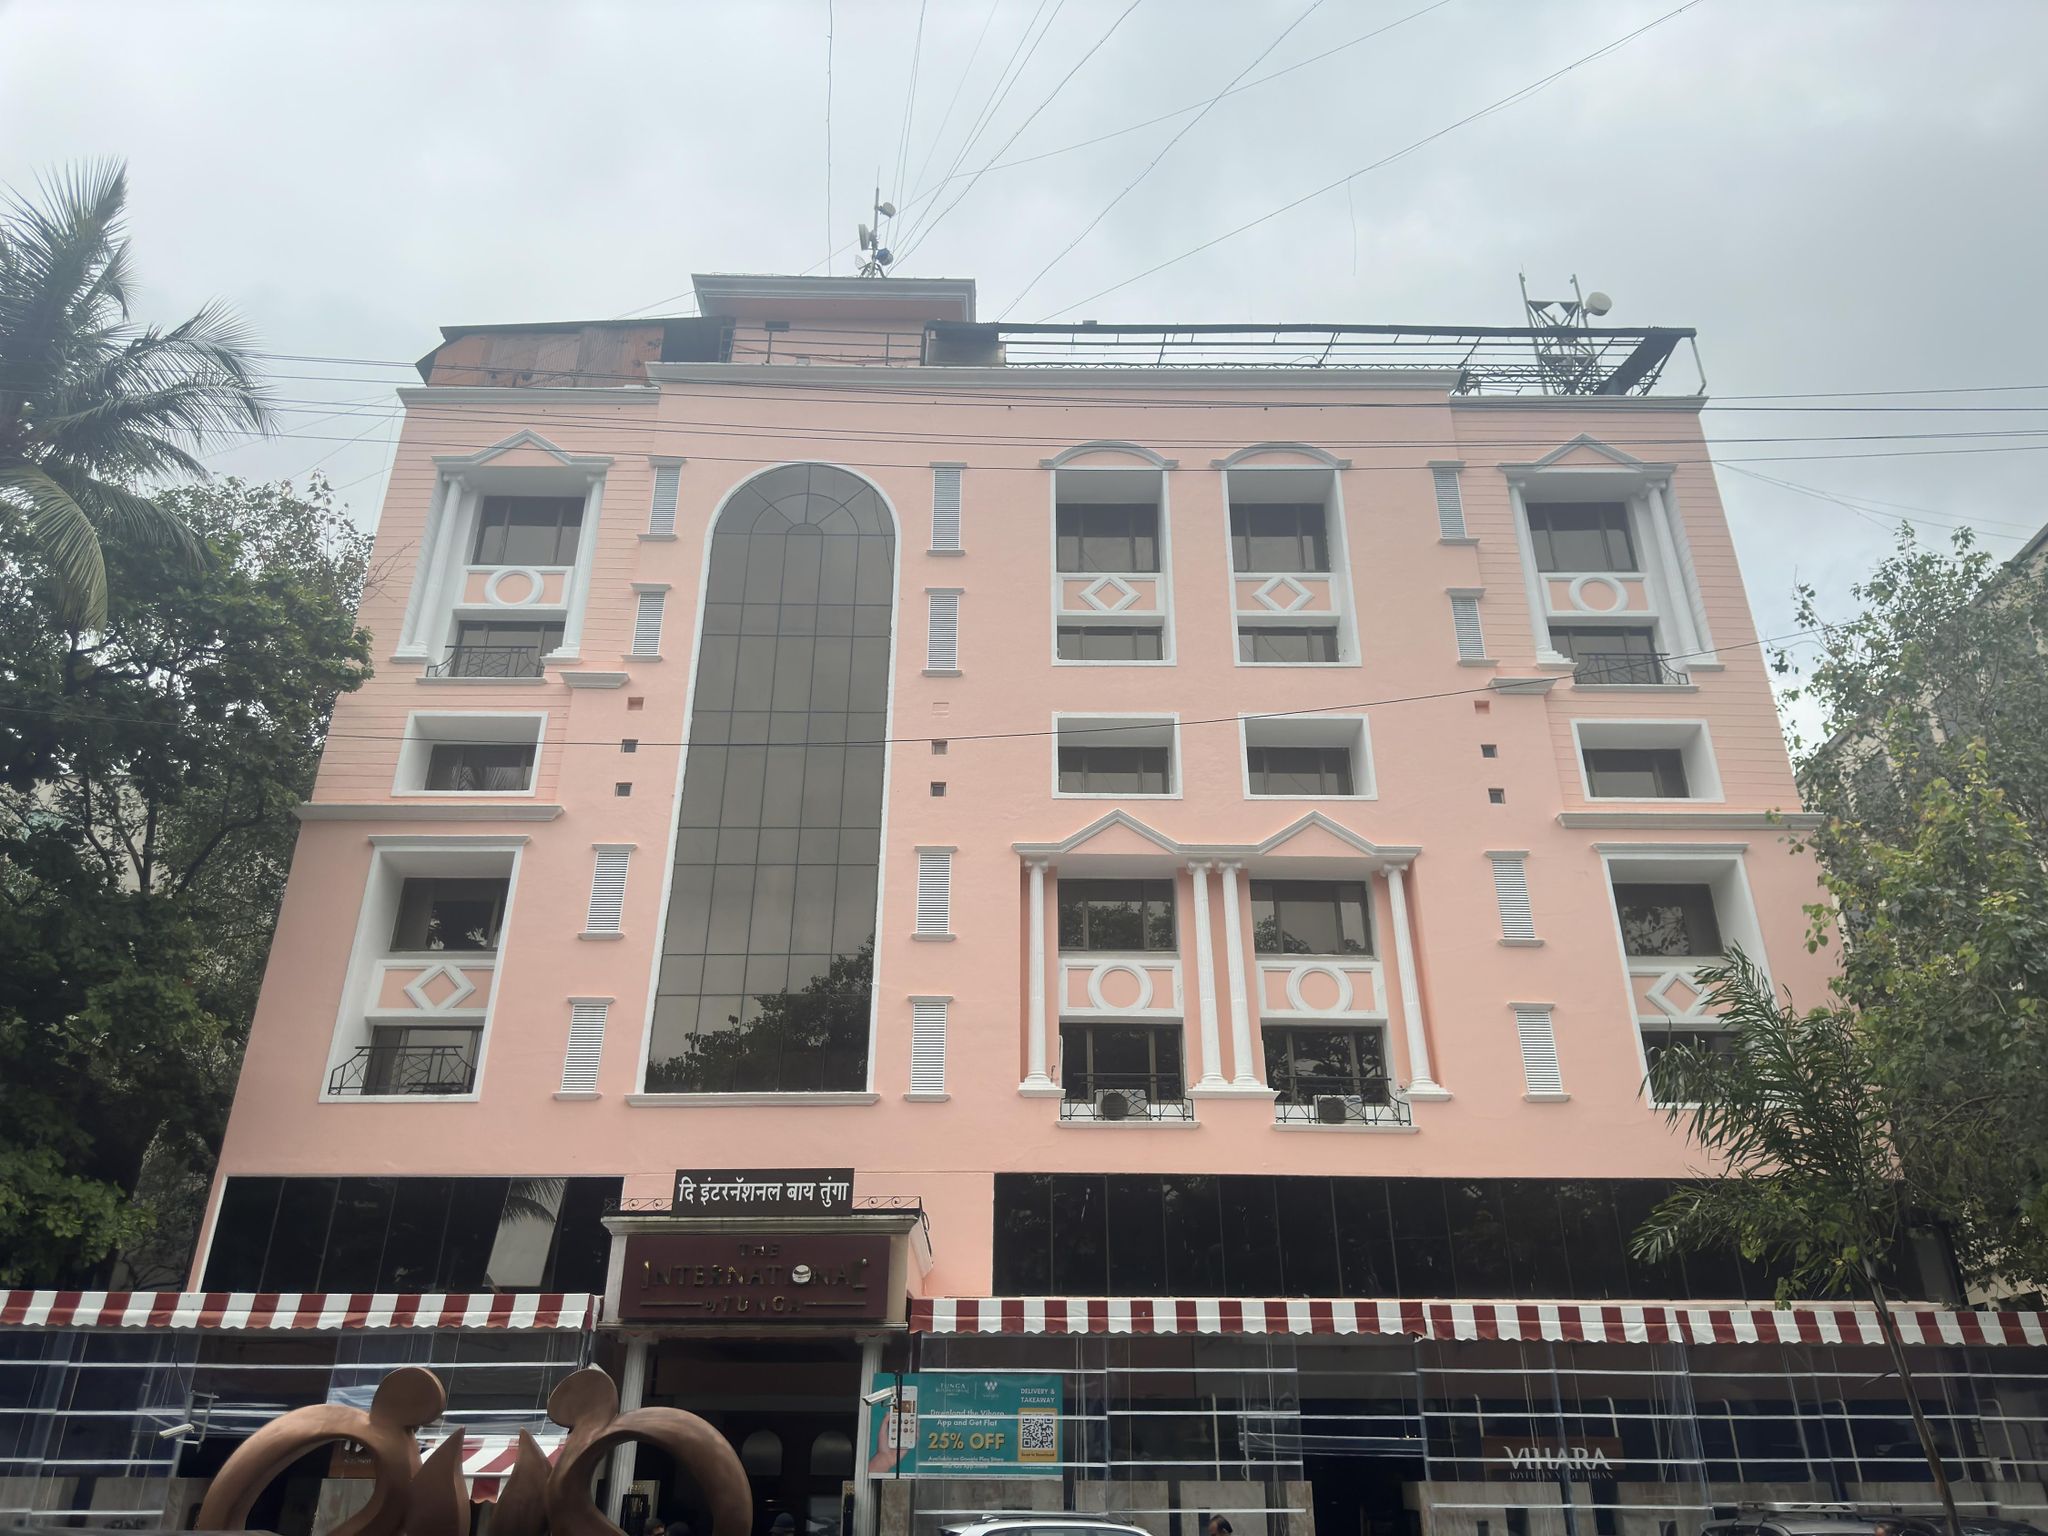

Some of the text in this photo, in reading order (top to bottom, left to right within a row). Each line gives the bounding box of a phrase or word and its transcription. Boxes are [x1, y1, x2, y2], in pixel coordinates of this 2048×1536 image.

[679, 1176, 849, 1207] दि इंटरनॅशनल बाय तुंगा
[738, 1244, 783, 1257] THE
[722, 1295, 802, 1312] TUNGA
[937, 1419, 952, 1427] App
[928, 1432, 1006, 1450] 25% OFF
[1503, 1446, 1613, 1470] VIHARA
